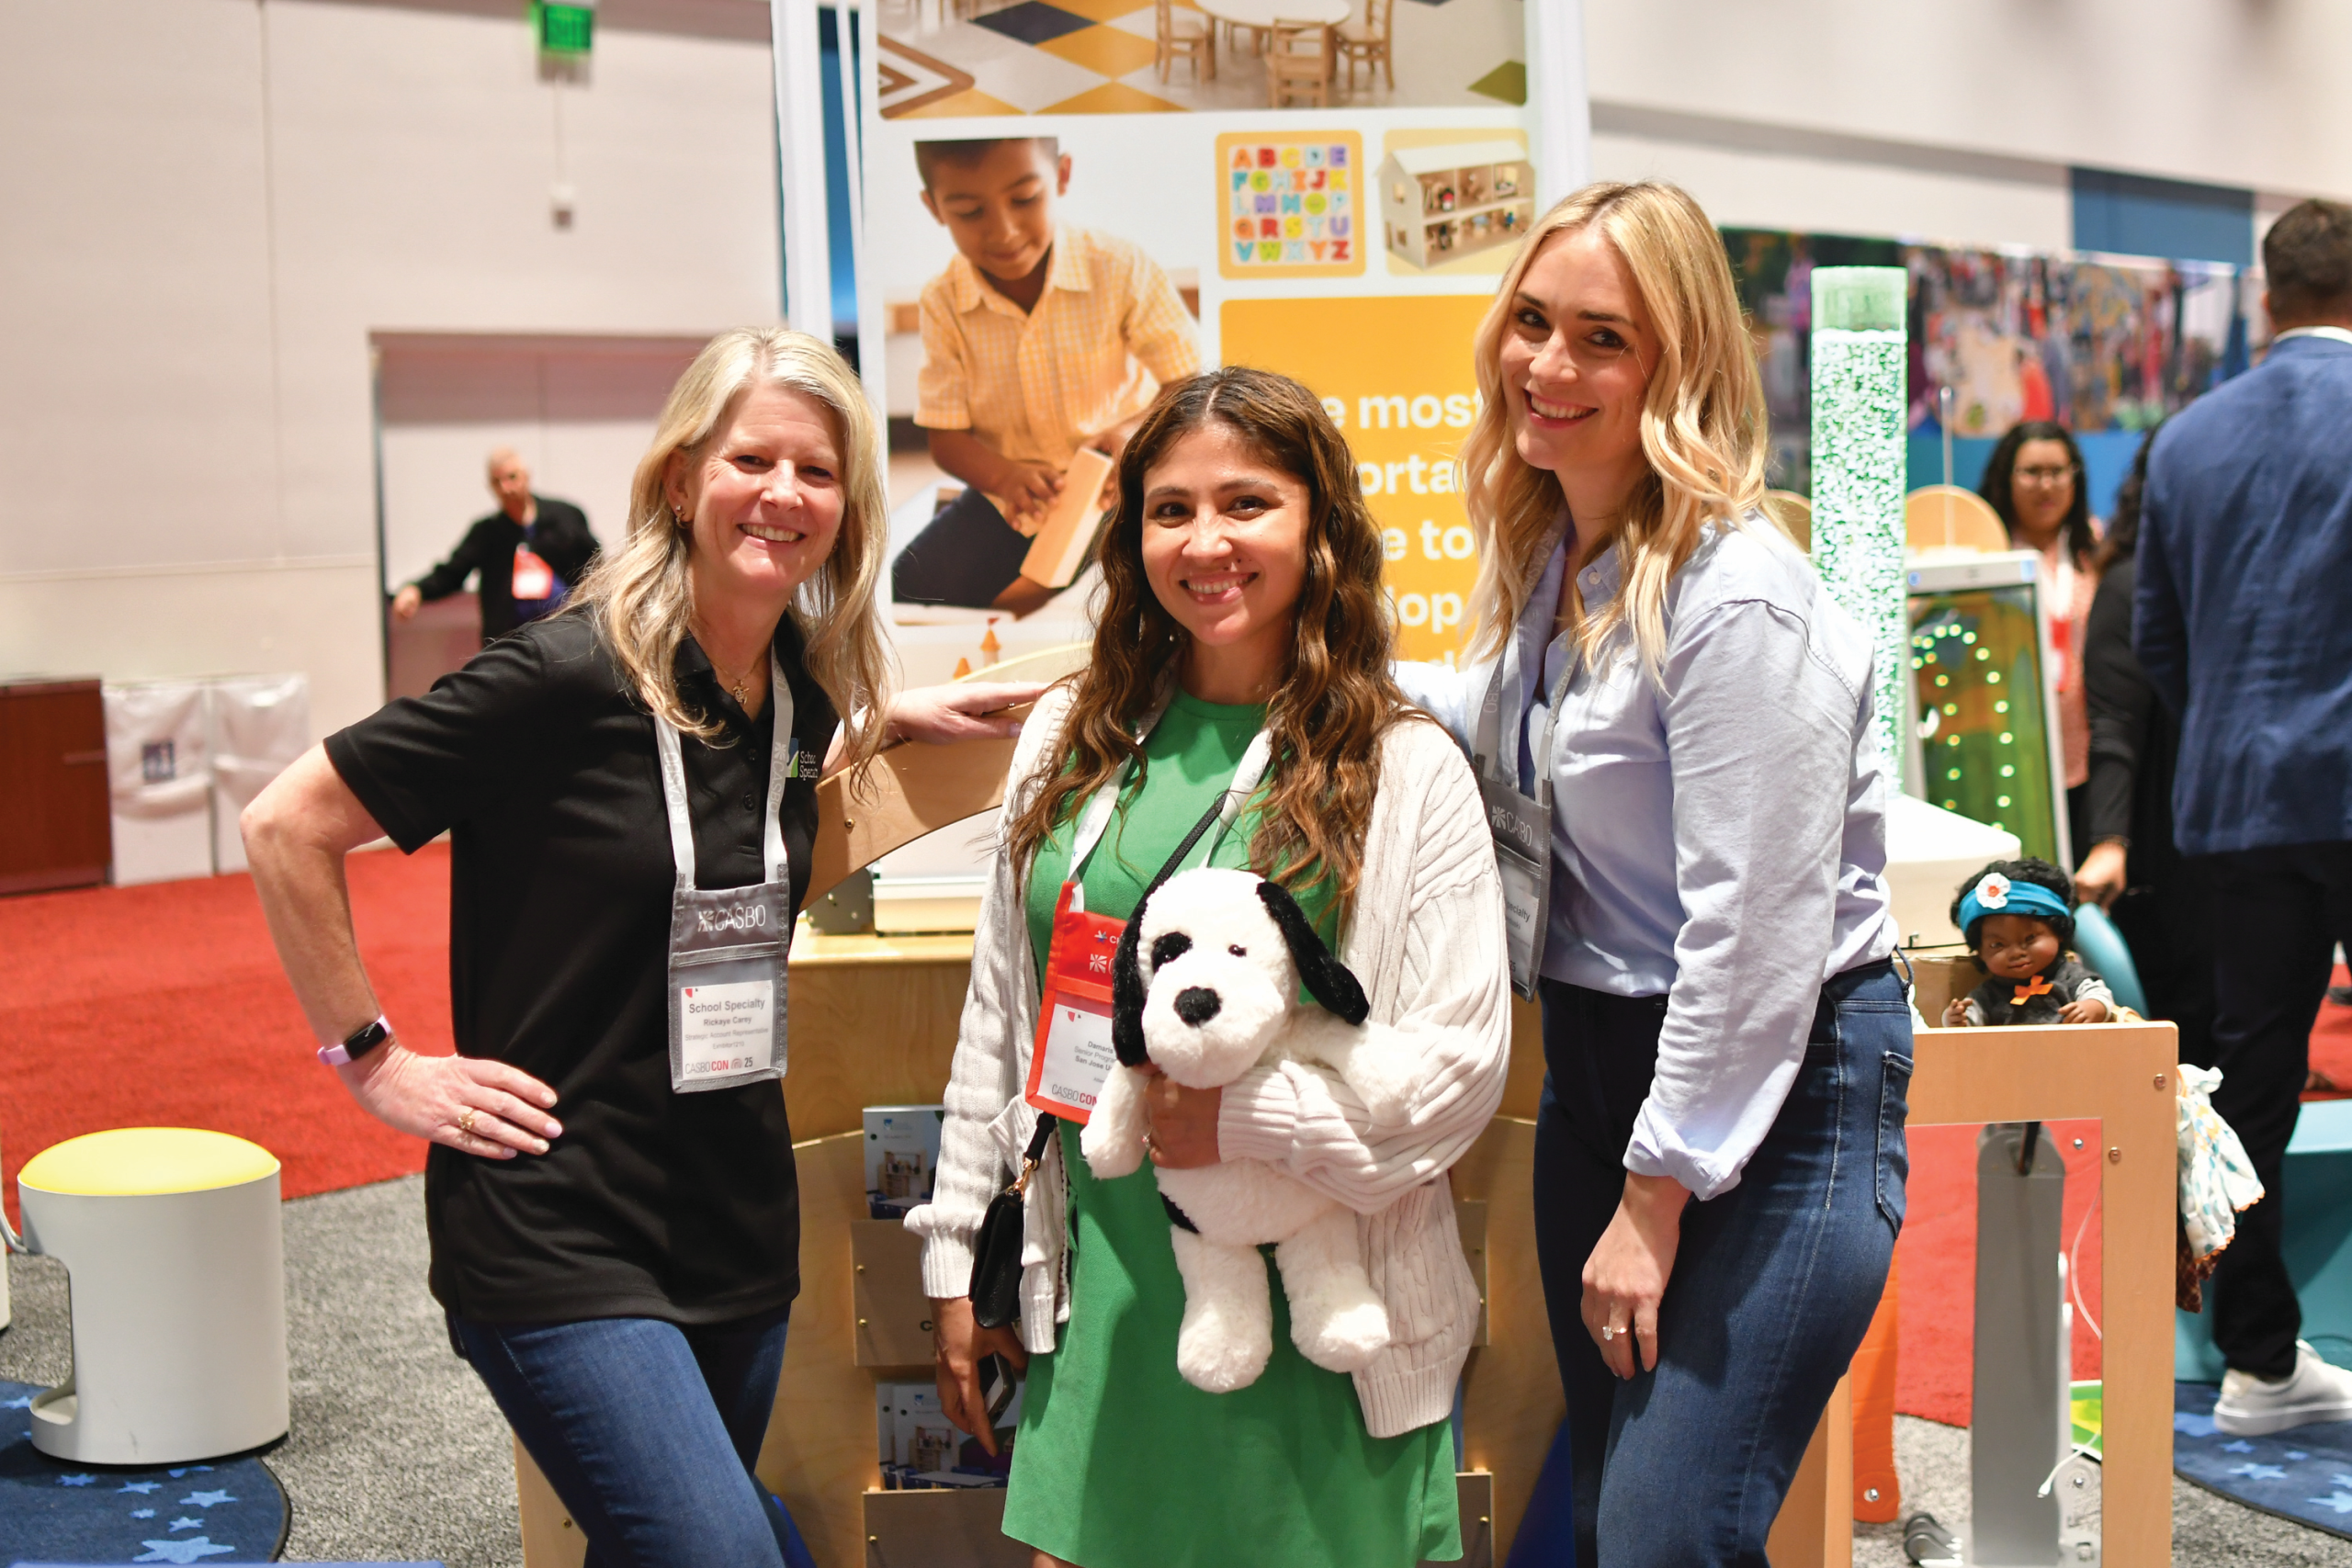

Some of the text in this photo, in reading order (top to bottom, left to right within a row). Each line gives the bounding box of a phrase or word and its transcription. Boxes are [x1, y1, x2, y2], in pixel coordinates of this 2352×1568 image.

[1419, 519, 1475, 561] to
[663, 752, 684, 805] CASBO
[770, 761, 785, 813] CASBO
[715, 905, 765, 931] CASBO
[689, 998, 765, 1014] School Specialty
[732, 1016, 752, 1024] Carey
[1074, 1046, 1093, 1056] Senior
[1088, 1041, 1114, 1054] Damaris
[744, 1057, 753, 1068] 25
[1075, 1055, 1087, 1065] San
[1089, 1060, 1103, 1069] Jose
